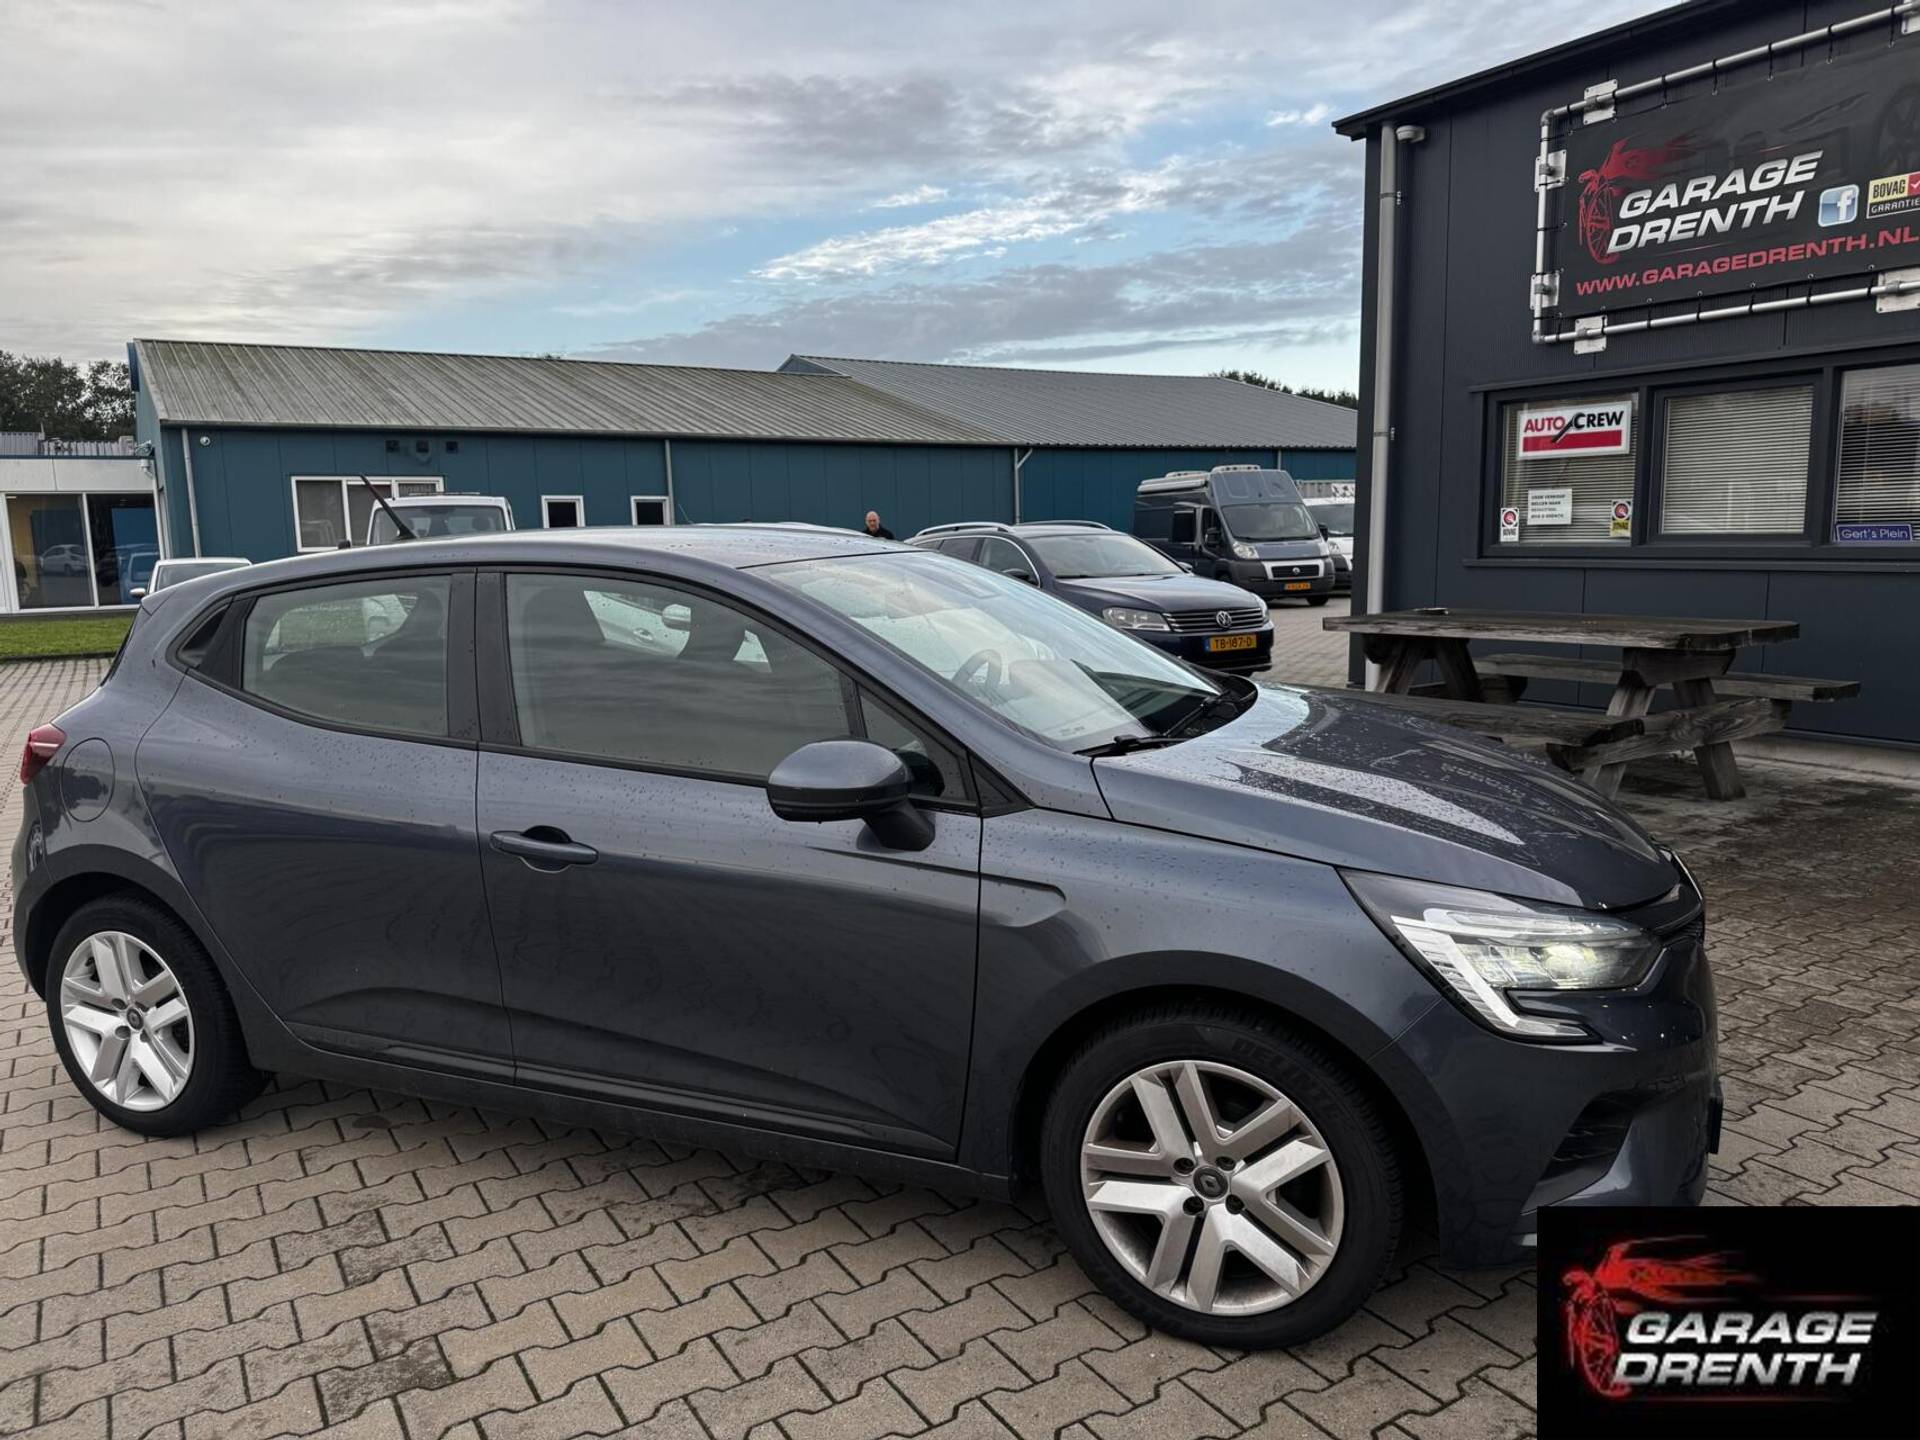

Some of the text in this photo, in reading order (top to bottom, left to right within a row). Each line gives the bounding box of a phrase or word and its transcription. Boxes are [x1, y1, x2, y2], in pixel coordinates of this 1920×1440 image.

[1618, 150, 1824, 220] GARAGE
[1873, 179, 1906, 199] BOVAG
[1871, 197, 1920, 214] GARANTIE
[1606, 191, 1805, 254] DRENTH
[1576, 226, 1920, 297] WWW.GARAGEDRENTH.NL
[1524, 410, 1625, 433] AUTO CREW
[1841, 527, 1909, 540] Gert's Plein
[1214, 636, 1252, 650] TB-187-D
